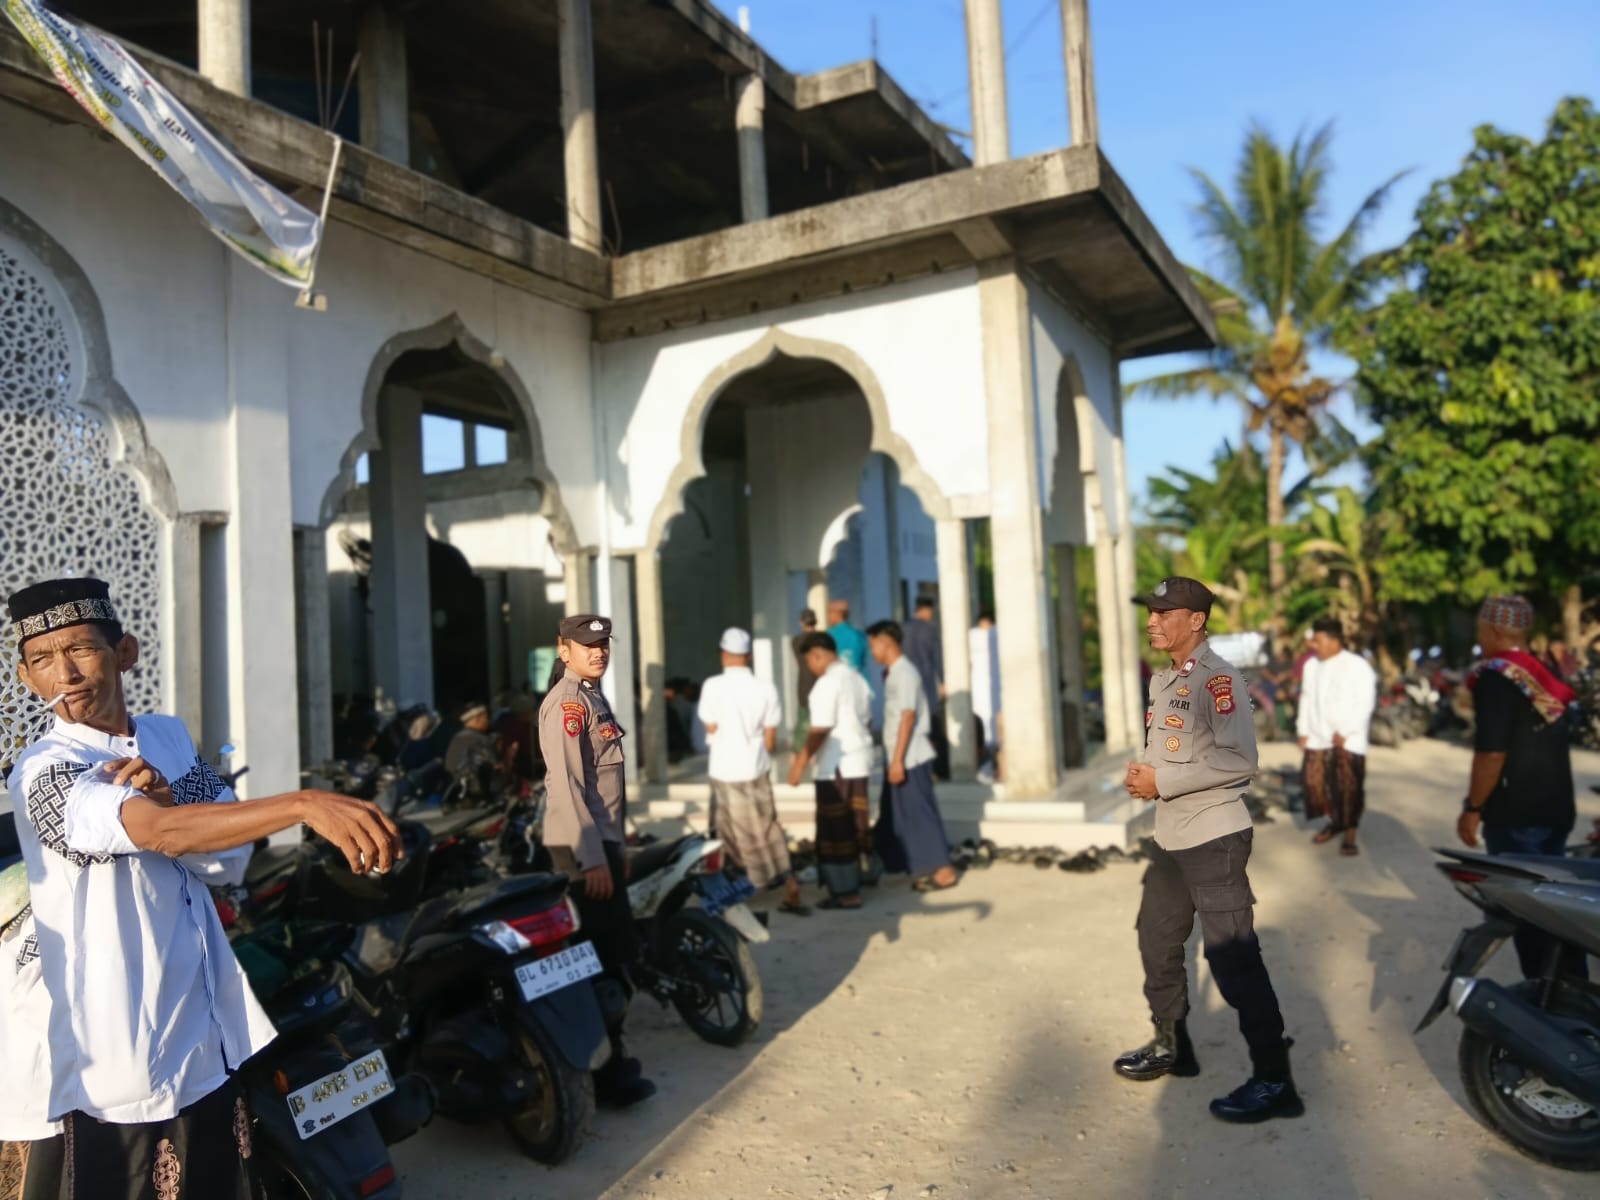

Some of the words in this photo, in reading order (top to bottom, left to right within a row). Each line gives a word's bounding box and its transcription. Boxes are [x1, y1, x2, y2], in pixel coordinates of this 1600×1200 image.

[1168, 699, 1190, 711] POLRI
[518, 967, 536, 983] BL
[293, 1095, 306, 1115] B
